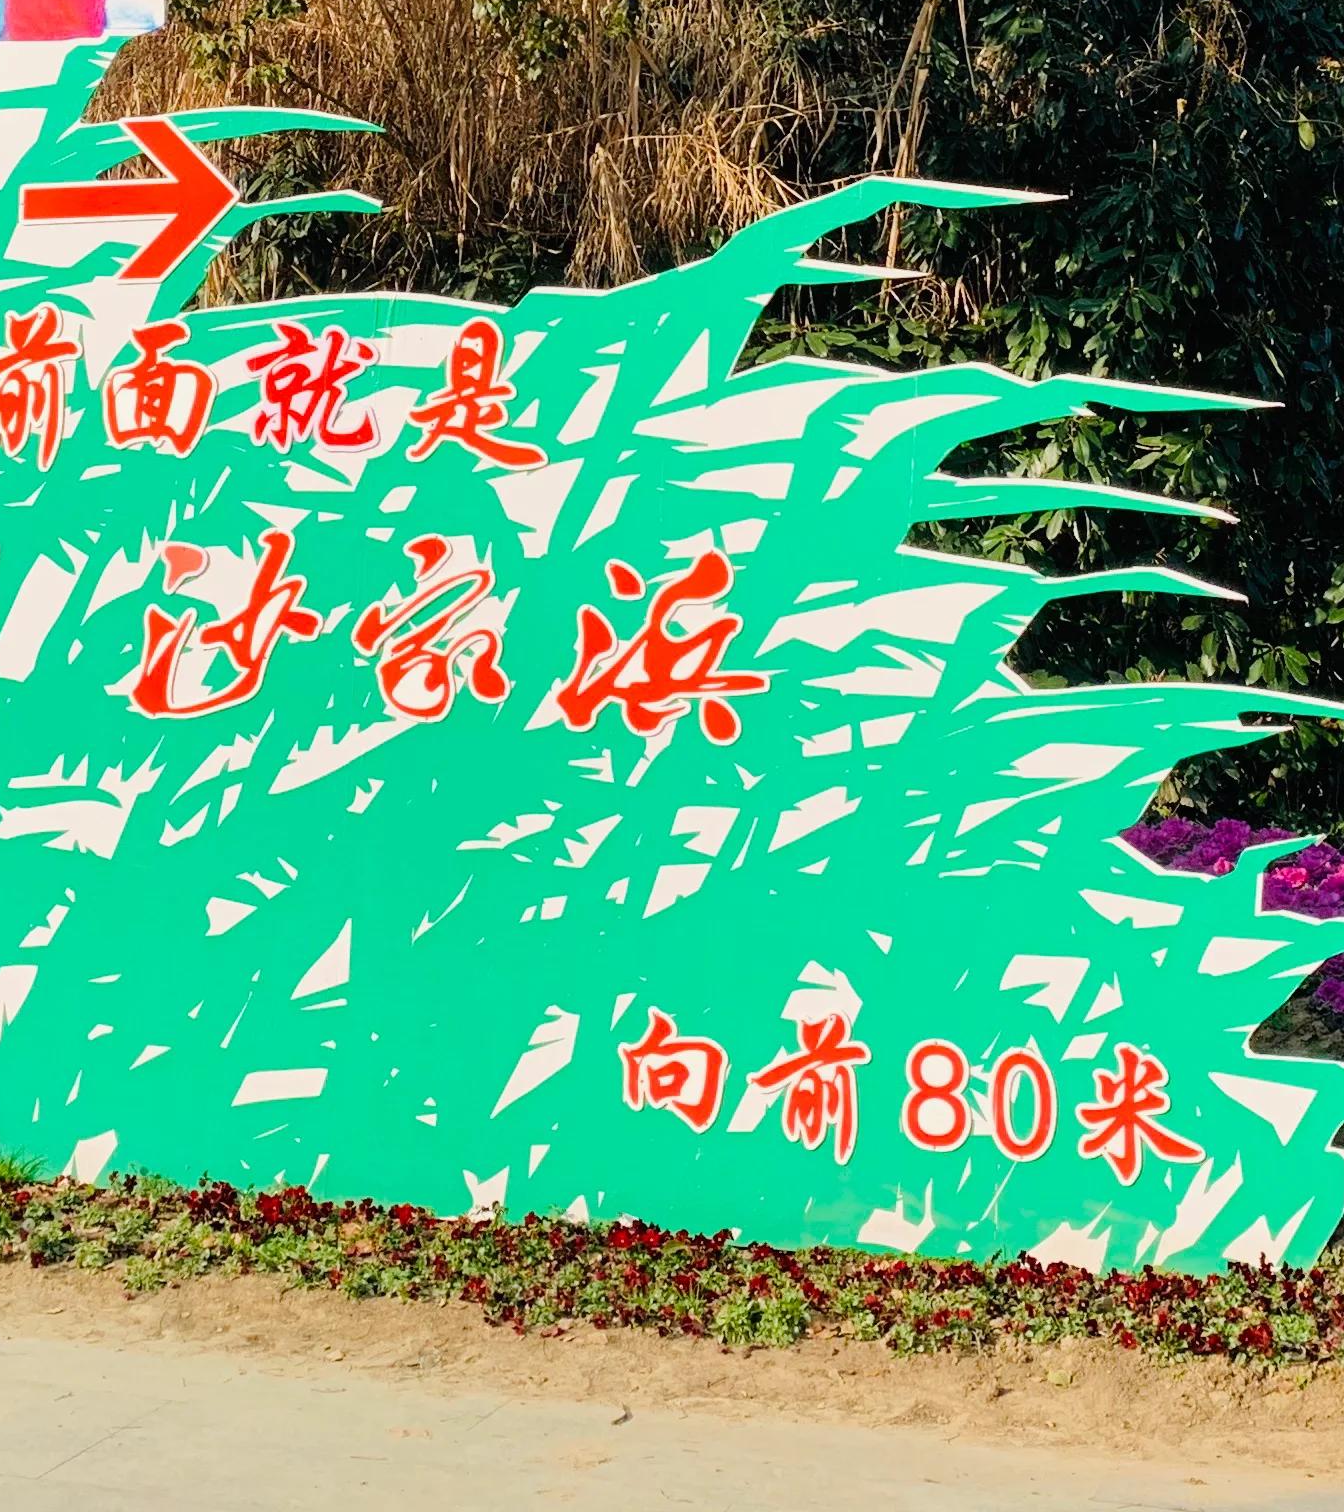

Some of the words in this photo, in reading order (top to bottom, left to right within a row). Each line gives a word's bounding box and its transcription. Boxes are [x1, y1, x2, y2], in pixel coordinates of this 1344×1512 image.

[132, 531, 769, 740] 沙家浜
[624, 1013, 1202, 1179] 向前80米
